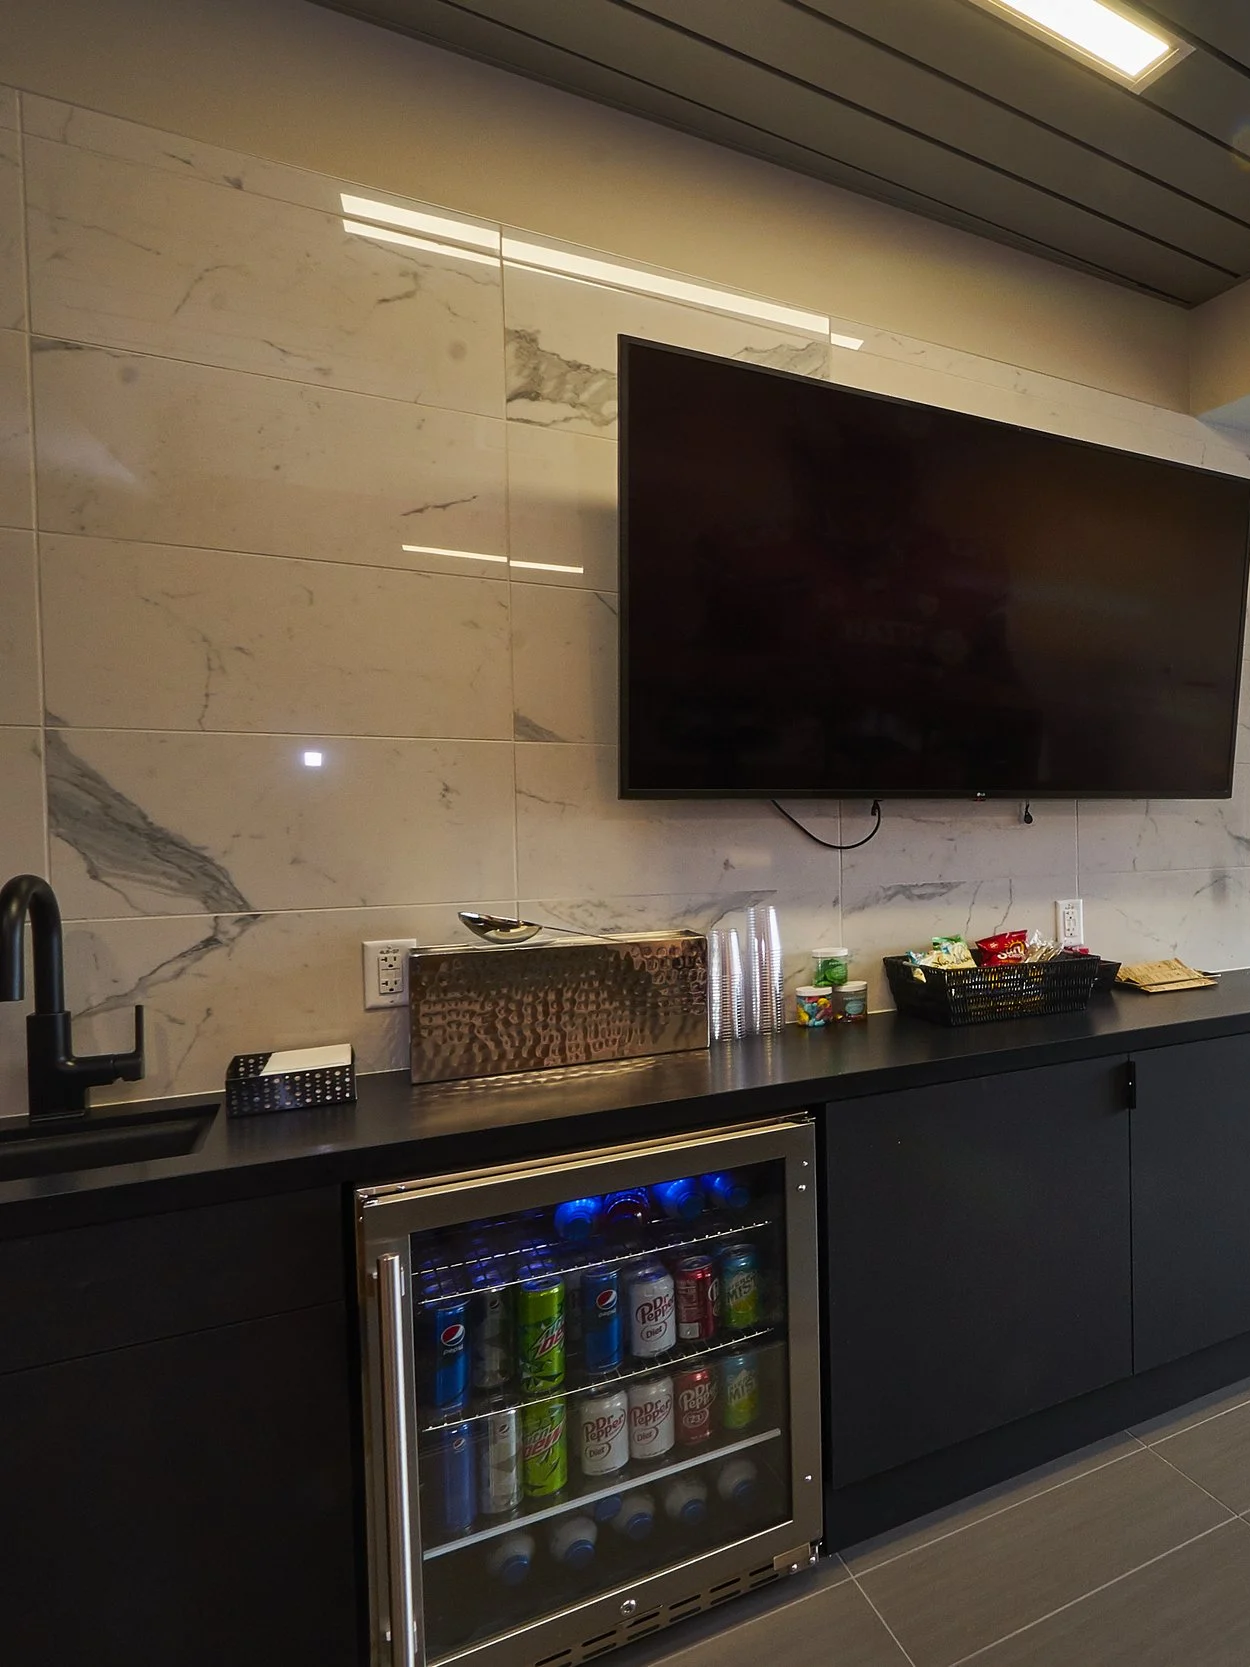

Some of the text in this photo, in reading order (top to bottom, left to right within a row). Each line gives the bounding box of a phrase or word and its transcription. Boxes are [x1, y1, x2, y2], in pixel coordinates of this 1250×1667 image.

[997, 945, 1025, 960] Sun
[653, 1293, 670, 1311] Dr
[635, 1298, 674, 1325] Peppe
[646, 1325, 662, 1339] Diet
[630, 1398, 671, 1427] Pepper
[643, 1399, 662, 1416] Dr
[583, 1413, 624, 1442] Pepper
[595, 1414, 614, 1431] Dr
